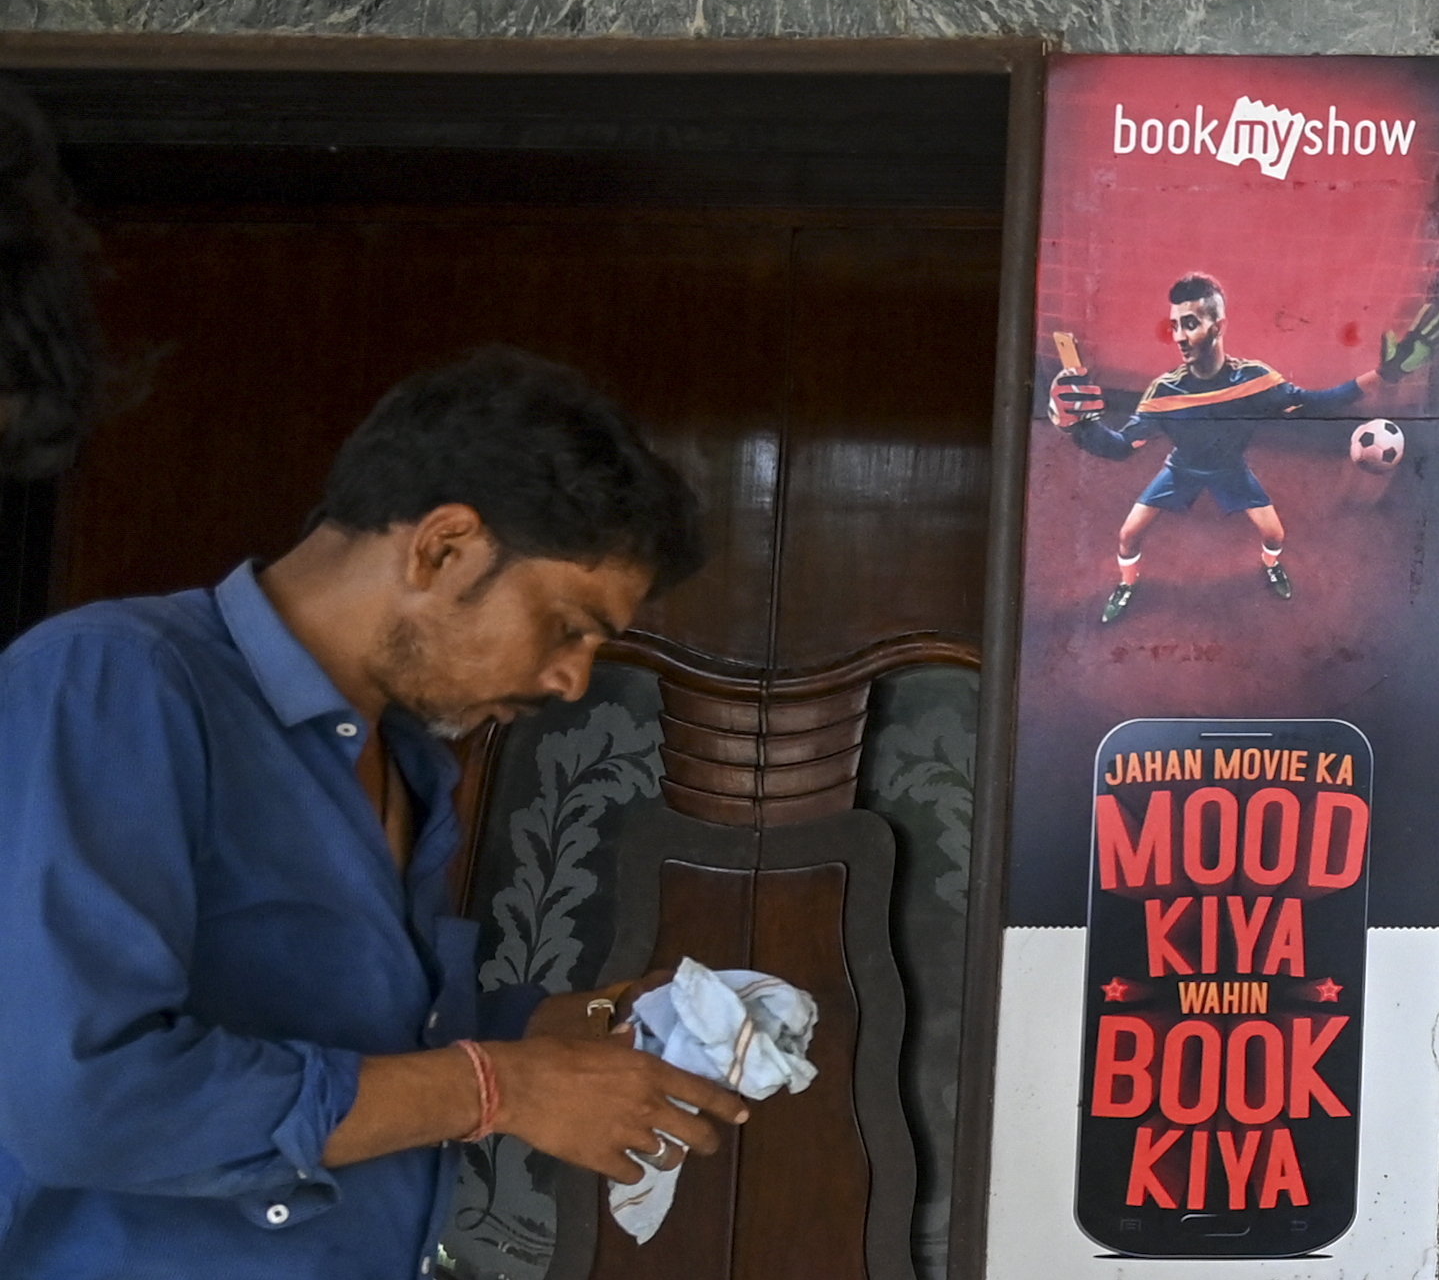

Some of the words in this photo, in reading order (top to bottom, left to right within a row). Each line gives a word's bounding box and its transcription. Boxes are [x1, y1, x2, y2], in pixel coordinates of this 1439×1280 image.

[1113, 95, 1416, 180] bookmyshow
[1105, 749, 1202, 786] JAHAN
[1214, 749, 1308, 782] MOVIE
[1315, 752, 1353, 786] KA
[1095, 787, 1369, 889] MOOD
[1145, 895, 1305, 977] KIYA
[1178, 981, 1269, 1015] WAHIN
[1091, 1015, 1352, 1125] BOOK
[1125, 1127, 1309, 1210] KIYA
